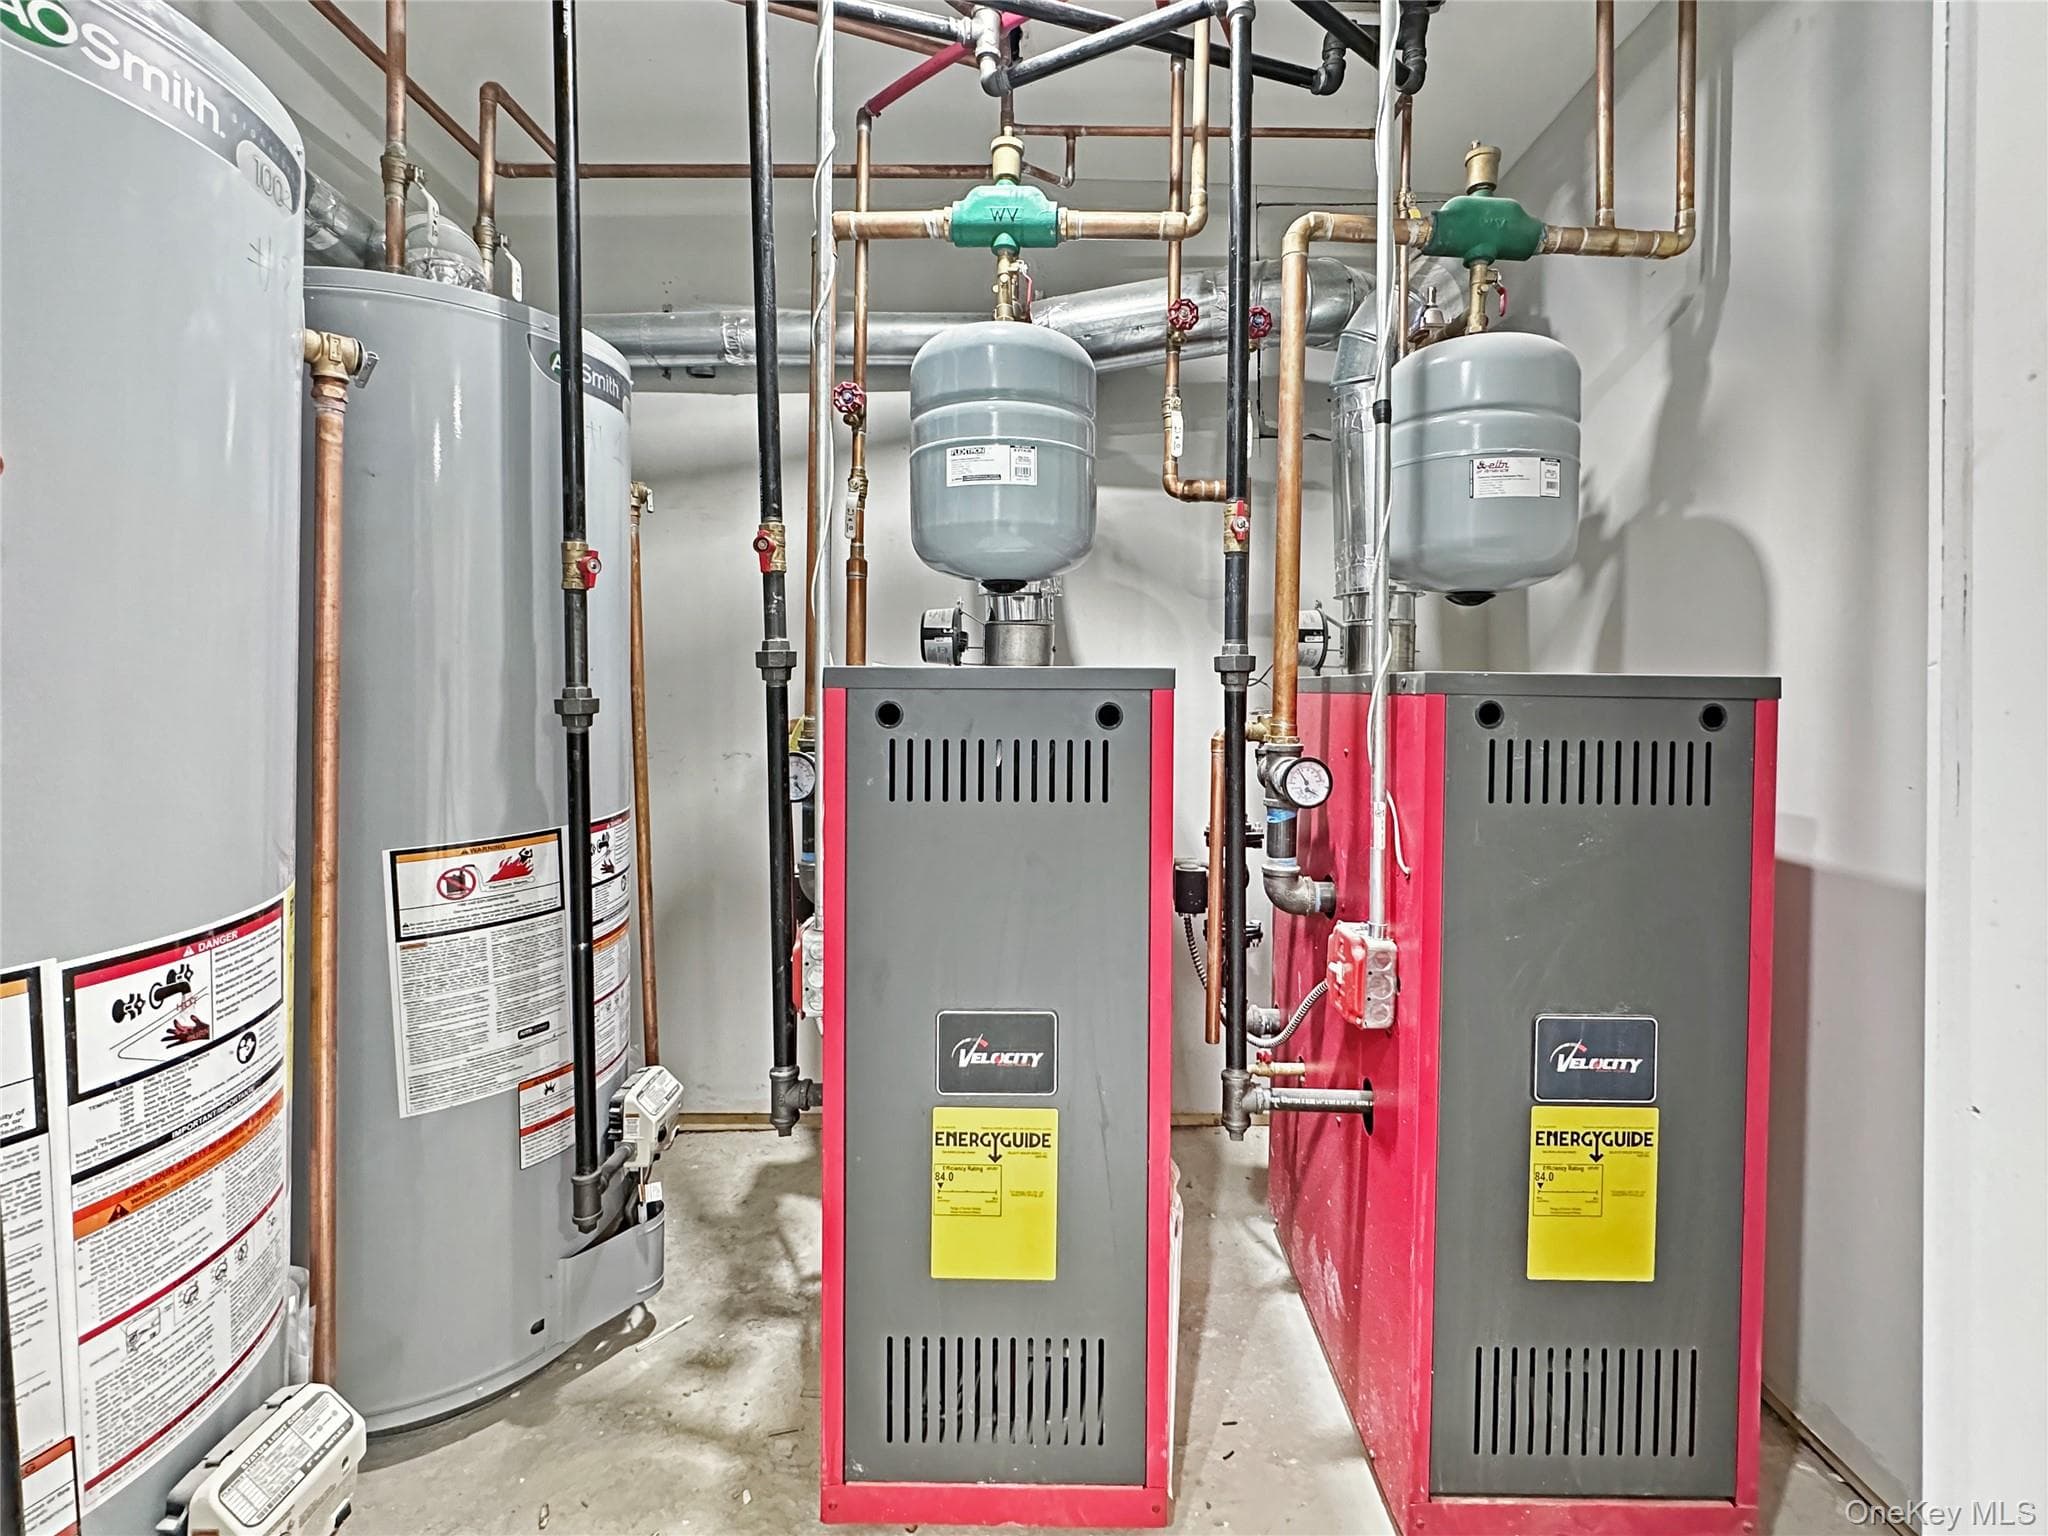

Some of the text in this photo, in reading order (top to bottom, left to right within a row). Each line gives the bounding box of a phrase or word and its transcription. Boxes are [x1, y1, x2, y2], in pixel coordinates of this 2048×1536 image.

[80, 22, 221, 137] Smith
[990, 207, 1019, 222] WV
[583, 362, 620, 398] Smith
[470, 844, 506, 855] WARNING
[198, 930, 238, 952] DANGER
[958, 1041, 1044, 1068] VELOCITY
[1557, 1047, 1644, 1074] VELOCITY
[172, 1110, 216, 1139] IMPORTANT
[935, 1131, 1051, 1149] ENERGYGUIDE
[1535, 1131, 1654, 1148] ENERGYGUIDE
[935, 1172, 954, 1182] 84.0
[1535, 1172, 1554, 1182] 84.0
[131, 1183, 168, 1205] WARNING
